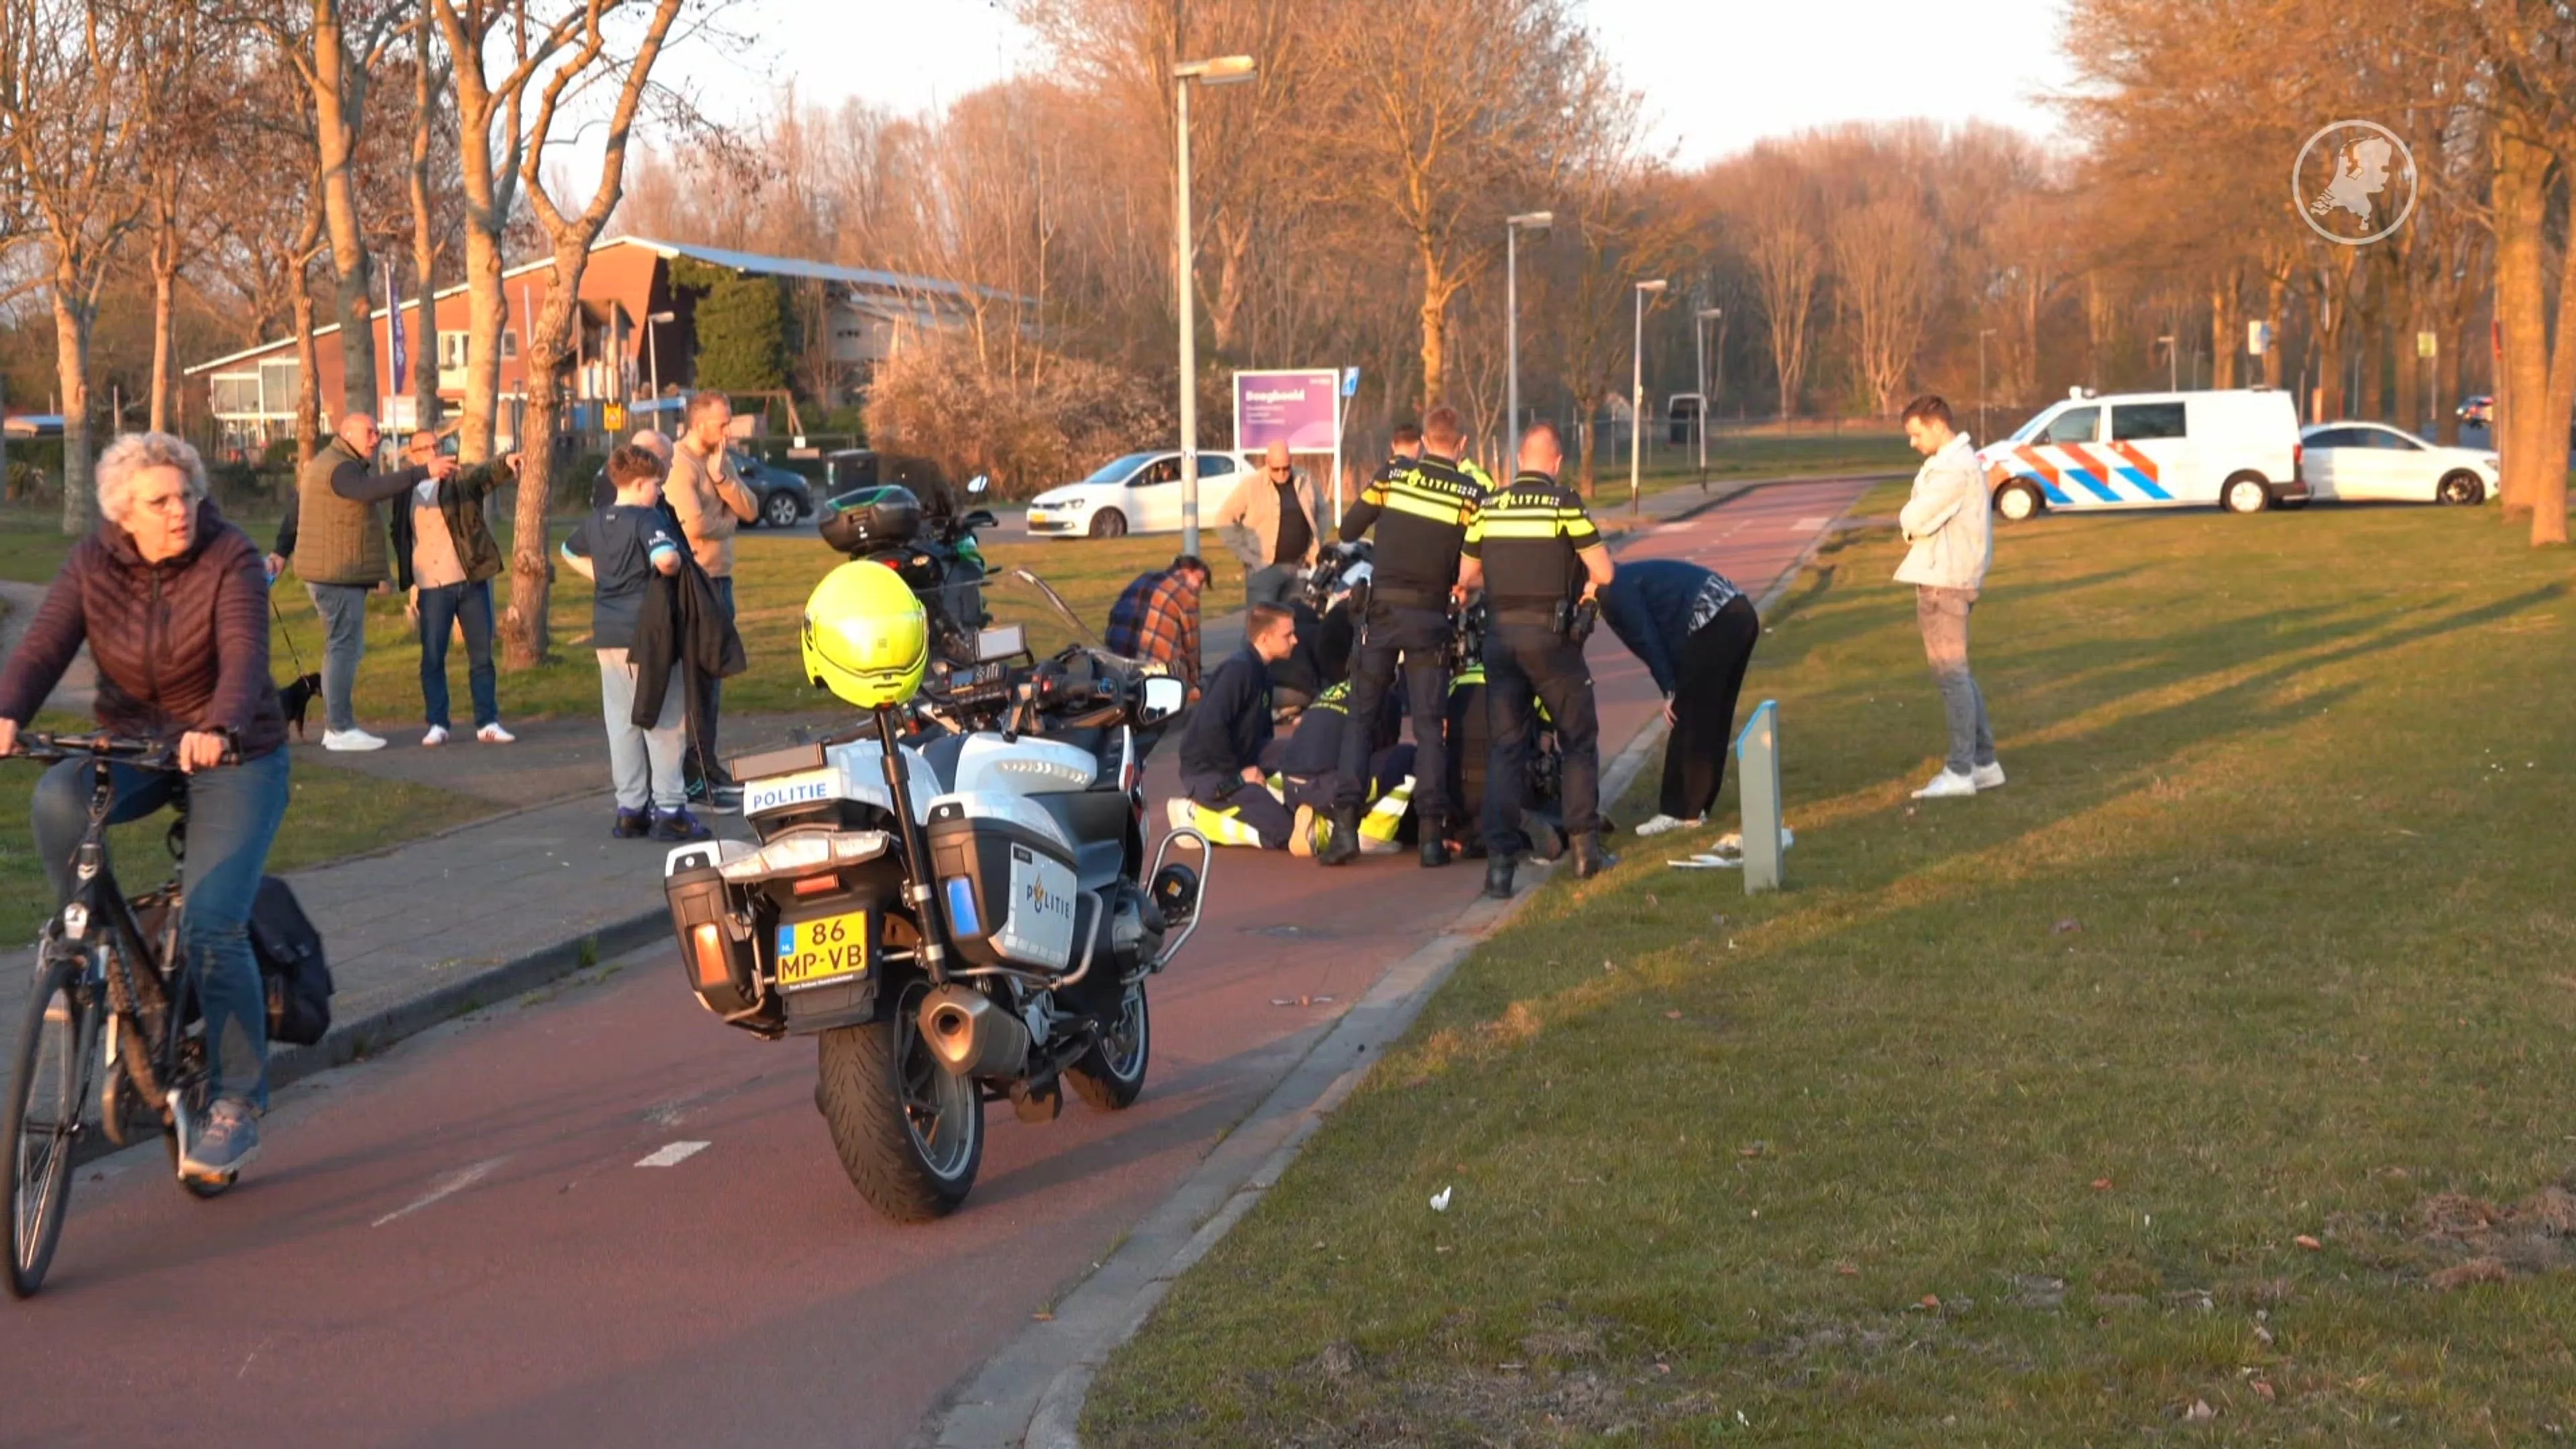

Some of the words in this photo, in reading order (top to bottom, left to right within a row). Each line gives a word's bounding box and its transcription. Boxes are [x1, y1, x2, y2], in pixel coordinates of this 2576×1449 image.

[753, 783, 826, 808] POLITIE
[1026, 883, 1069, 920] POLITIE
[812, 919, 845, 946] 86
[782, 944, 862, 980] MP-VB
